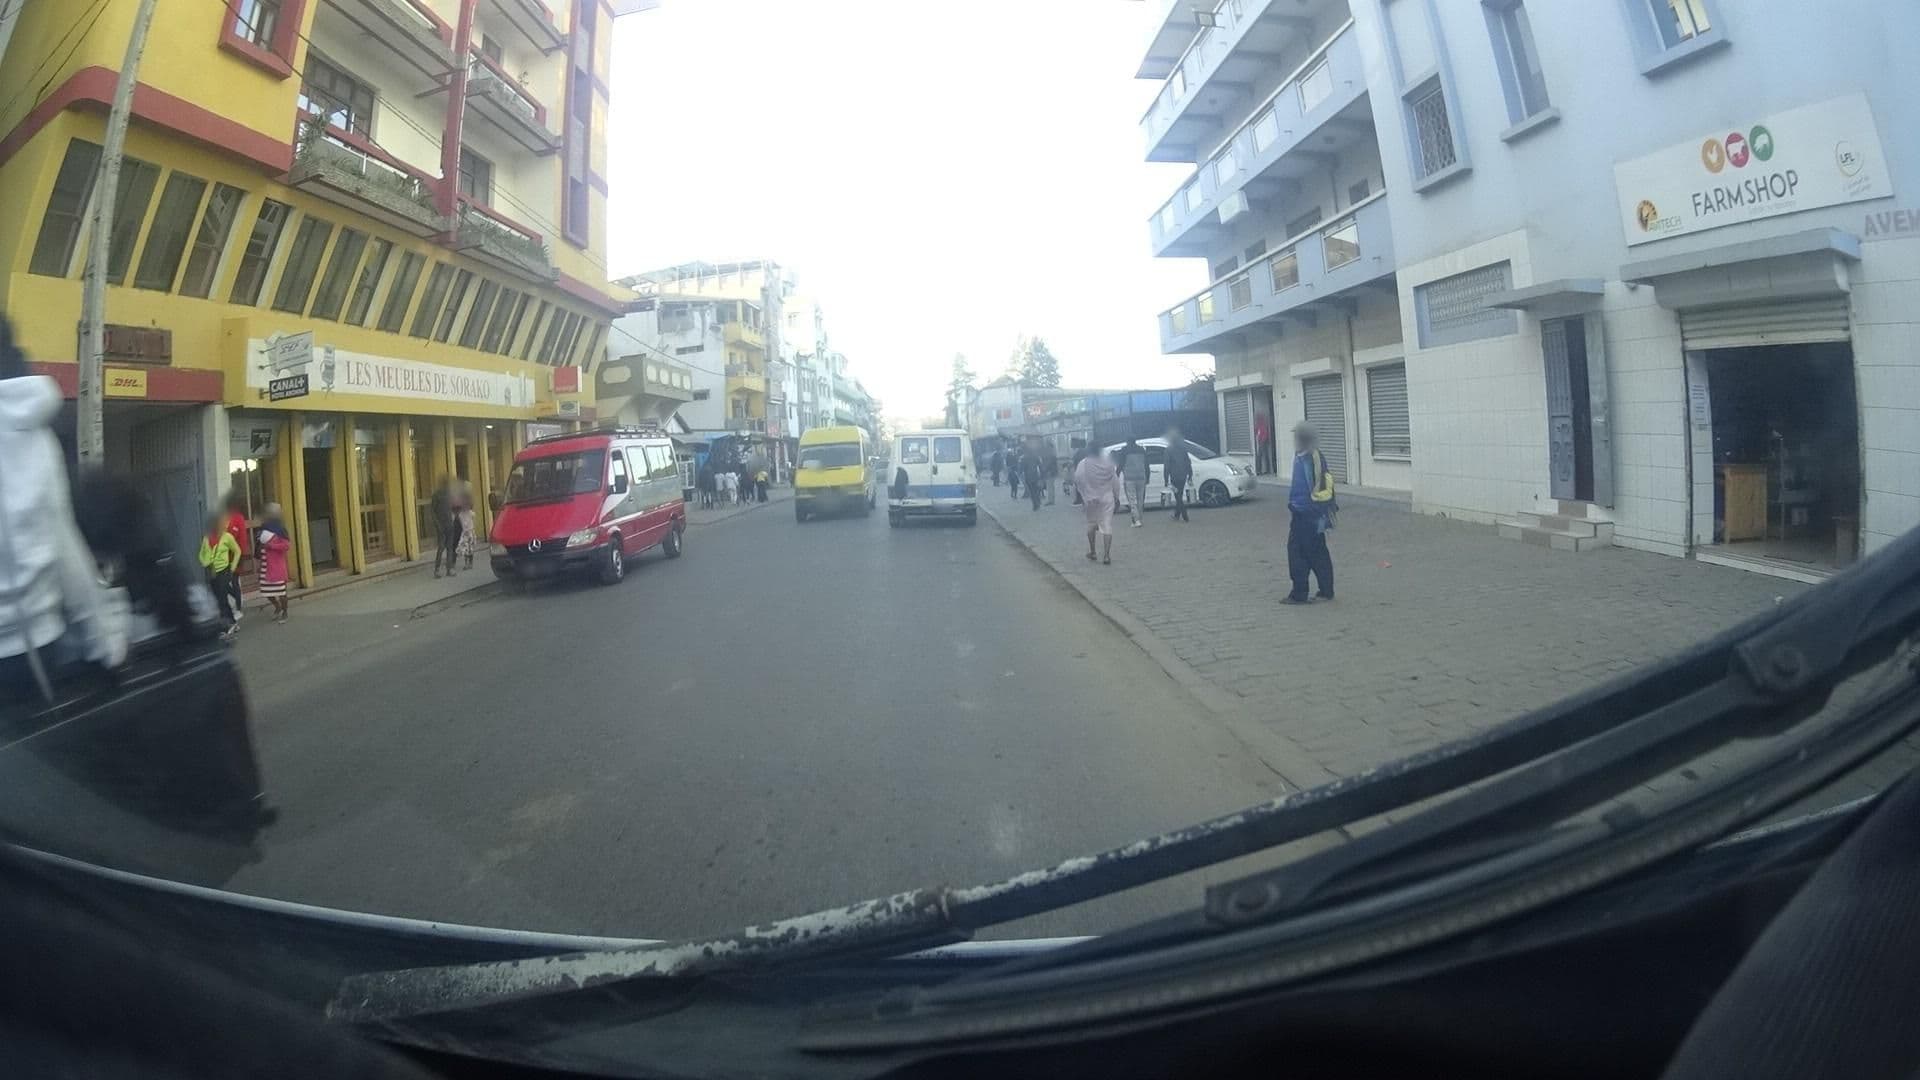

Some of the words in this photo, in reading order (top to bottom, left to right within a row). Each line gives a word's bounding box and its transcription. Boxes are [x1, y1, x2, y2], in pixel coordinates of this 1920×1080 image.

[1692, 169, 1798, 217] FARMSHOP
[111, 378, 138, 387] DHL
[271, 376, 305, 393] CANAL+
[345, 360, 372, 387] LES
[375, 365, 432, 393] MEUBLES
[434, 372, 448, 395] DE
[450, 376, 490, 400] SORAKO
